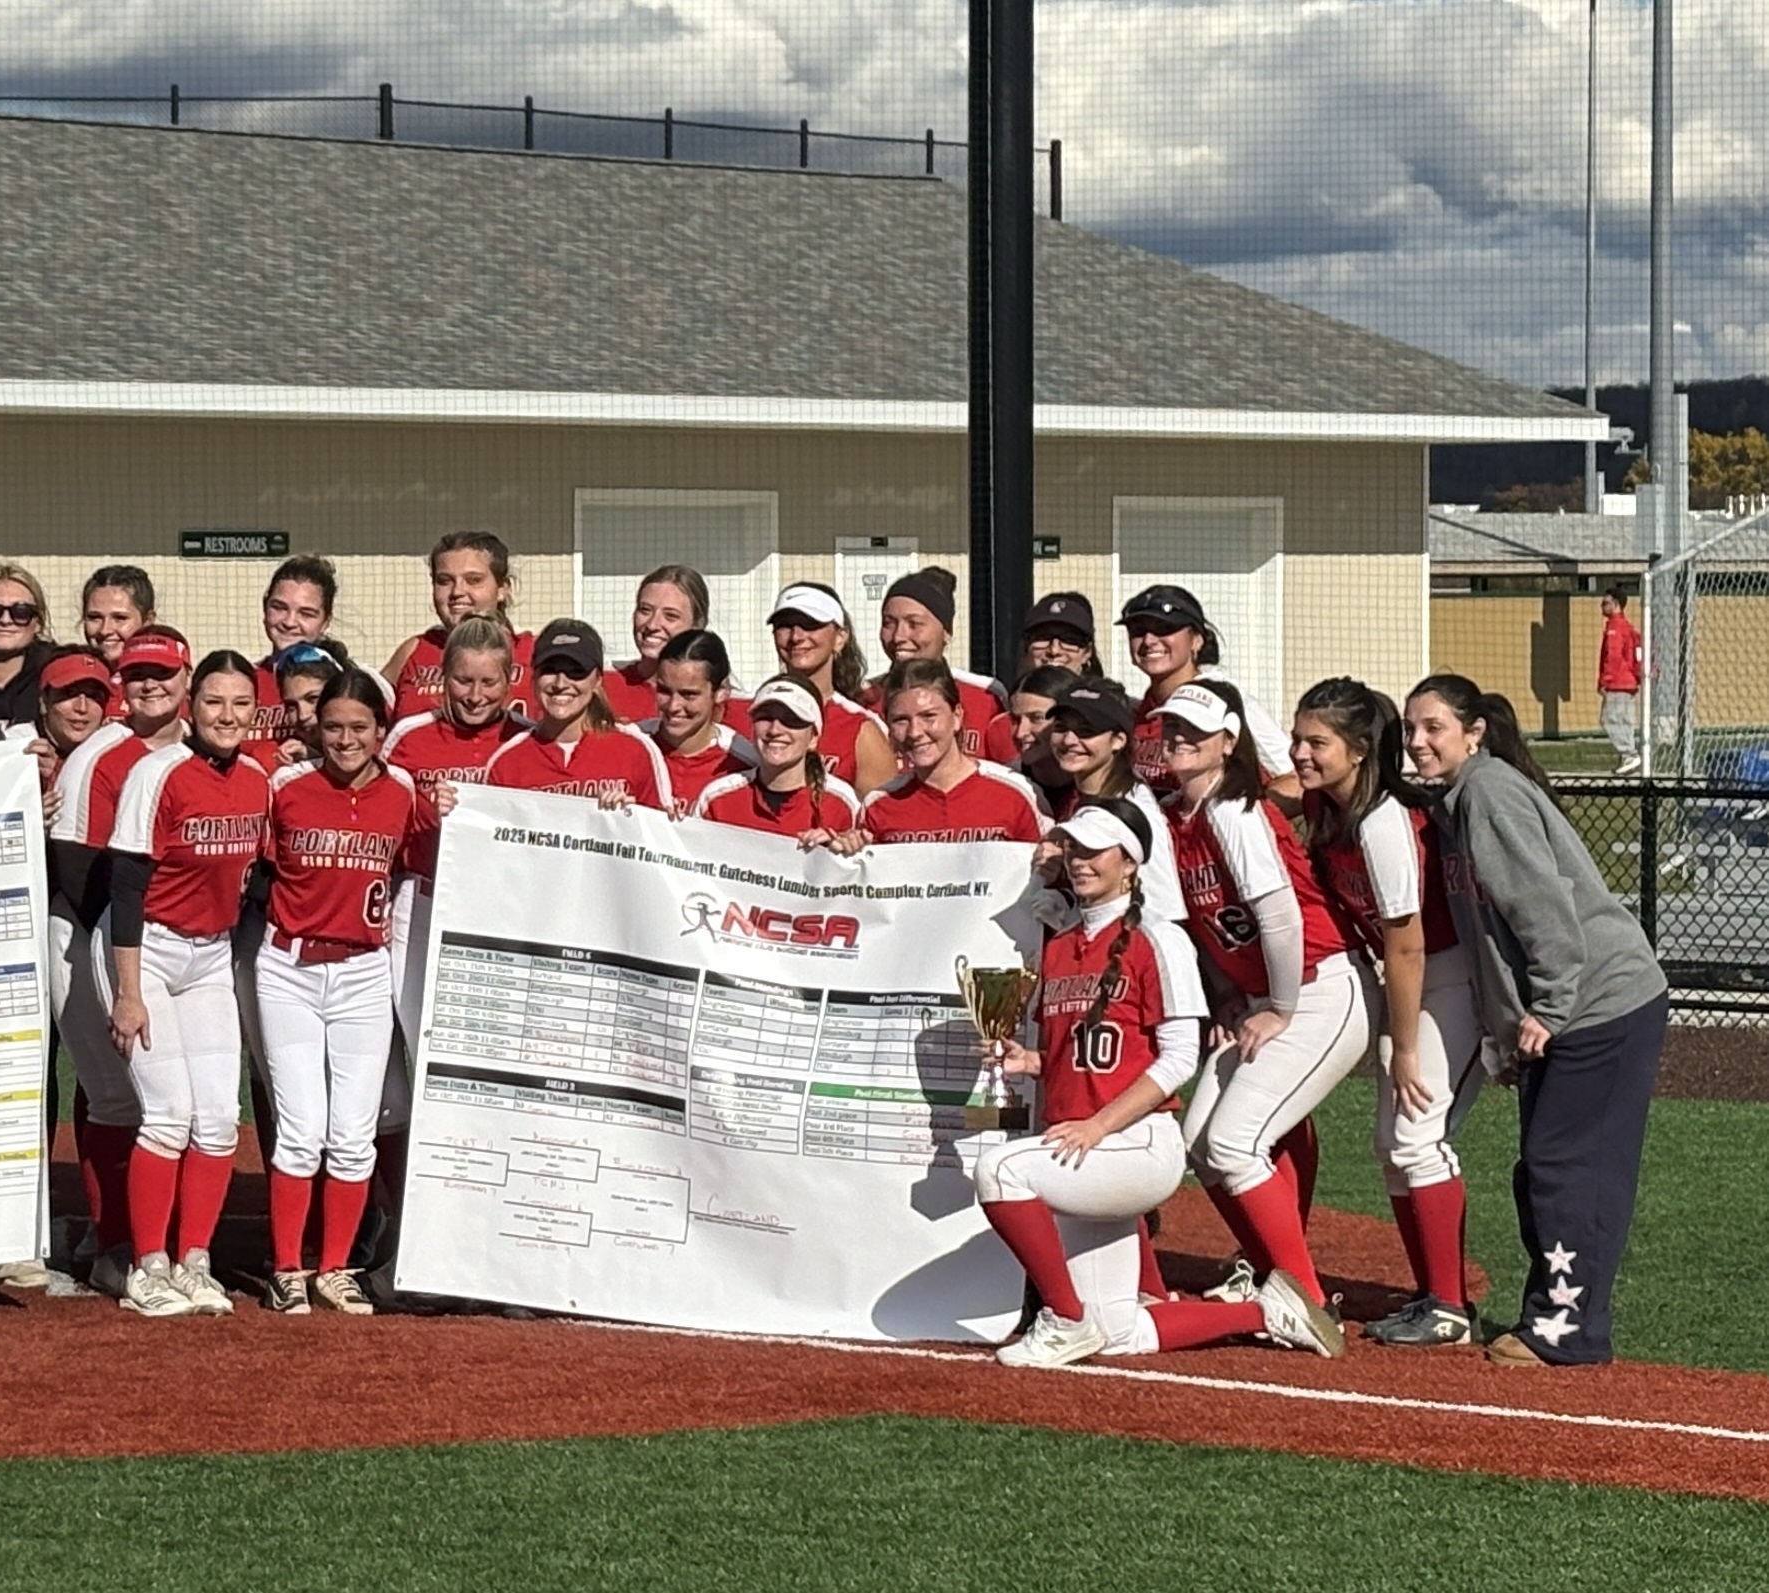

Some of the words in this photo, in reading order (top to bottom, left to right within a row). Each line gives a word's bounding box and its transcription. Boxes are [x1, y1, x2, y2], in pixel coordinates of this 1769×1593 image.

[204, 536, 268, 553] RESTROOMS
[493, 826, 526, 844] 2025
[528, 830, 561, 849] NCSA
[563, 835, 614, 856] Cortland
[616, 843, 636, 861] Fall
[720, 864, 776, 889] Gutchess
[778, 876, 821, 899] Lumber
[823, 885, 863, 899] Sports
[721, 902, 860, 948] NCSA
[1070, 1020, 1124, 1074] 10
